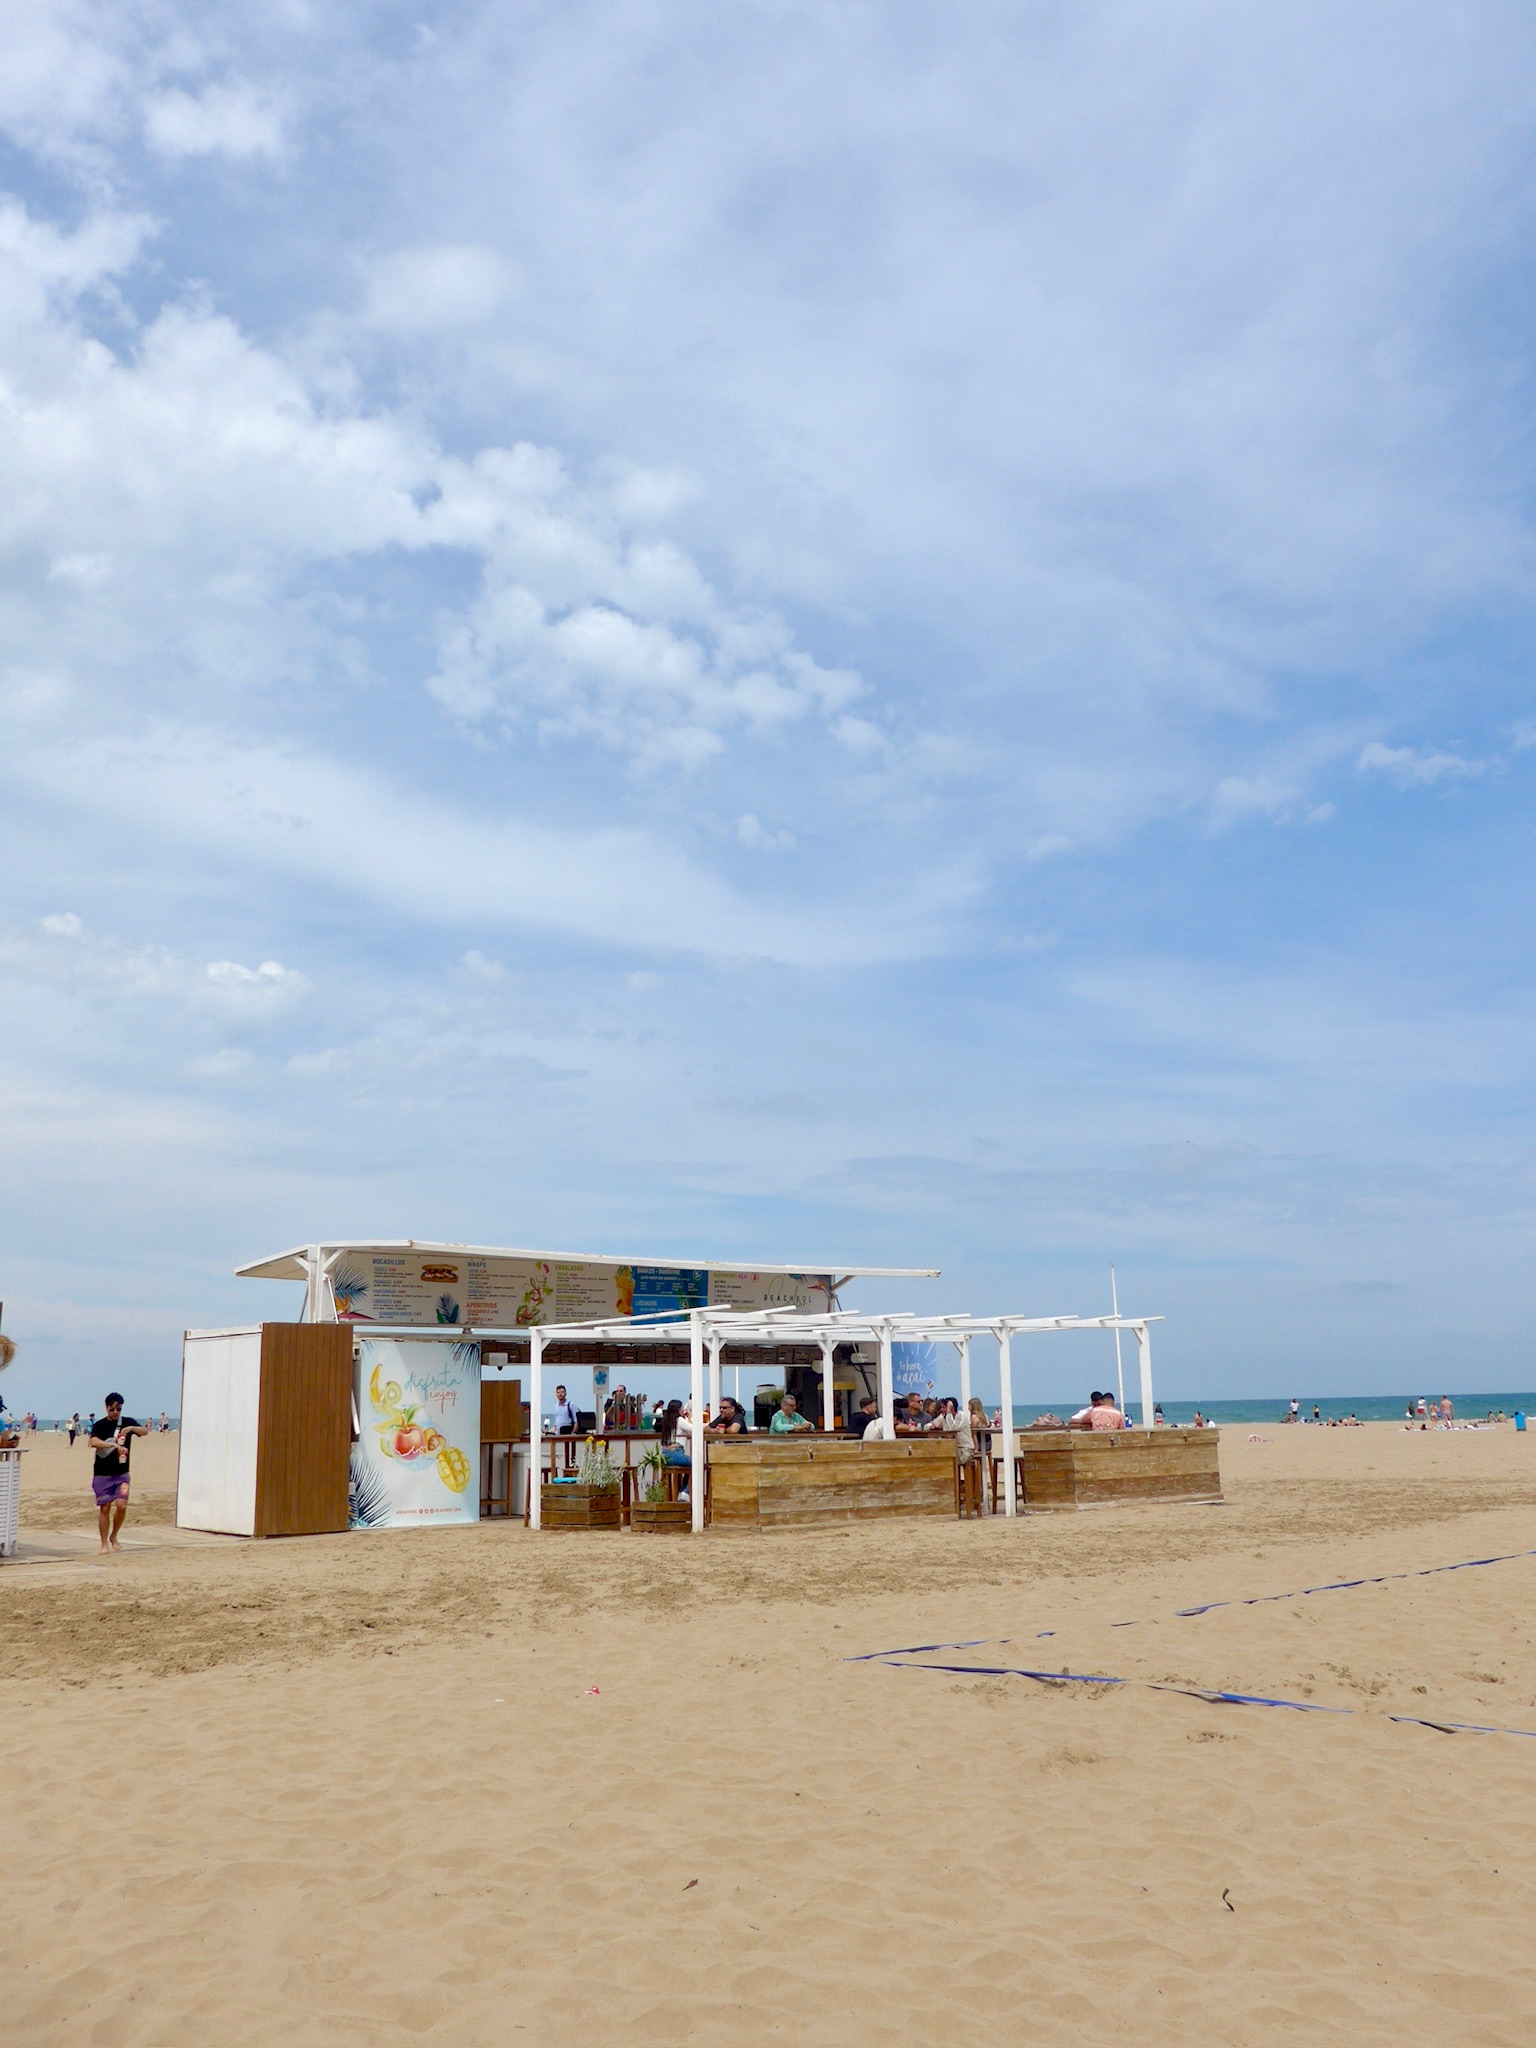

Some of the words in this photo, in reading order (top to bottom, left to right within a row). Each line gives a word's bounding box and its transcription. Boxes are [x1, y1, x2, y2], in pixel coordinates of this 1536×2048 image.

[372, 1258, 406, 1266] BOCADILLOS
[555, 1264, 584, 1272] ENSALADAS
[404, 1361, 462, 1401] disfruta
[429, 1388, 460, 1415] enjoy
